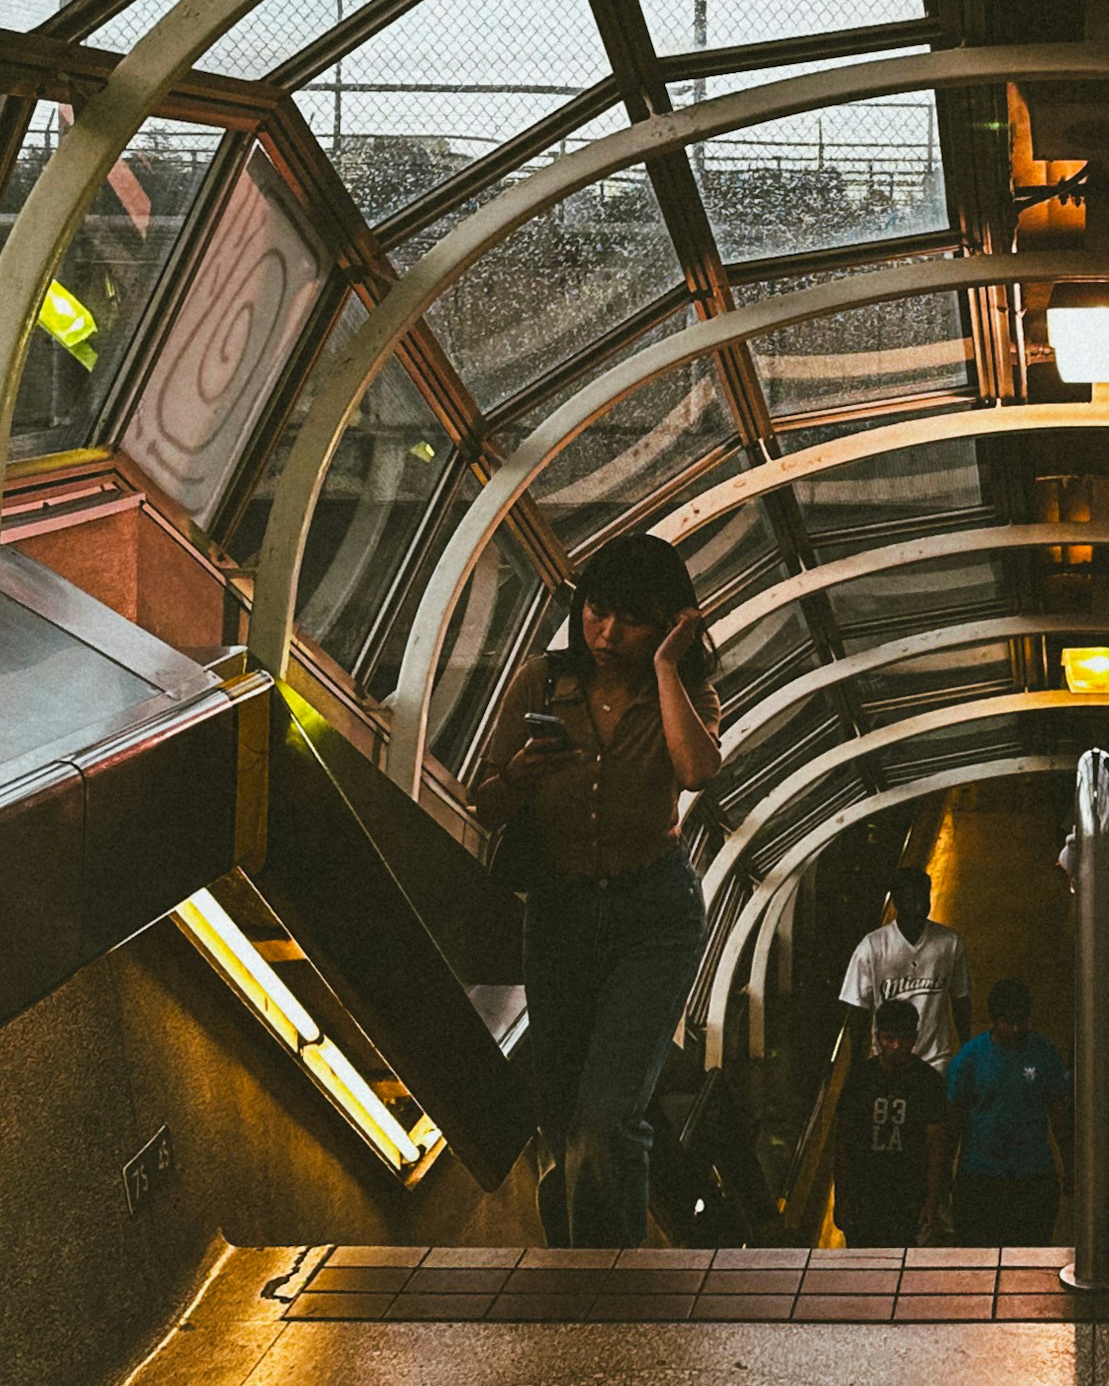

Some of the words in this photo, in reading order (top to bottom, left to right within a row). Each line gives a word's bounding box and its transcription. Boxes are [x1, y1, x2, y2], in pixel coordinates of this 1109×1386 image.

[881, 977, 943, 1000] Miami
[873, 1098, 906, 1124] 83
[872, 1125, 903, 1151] LA
